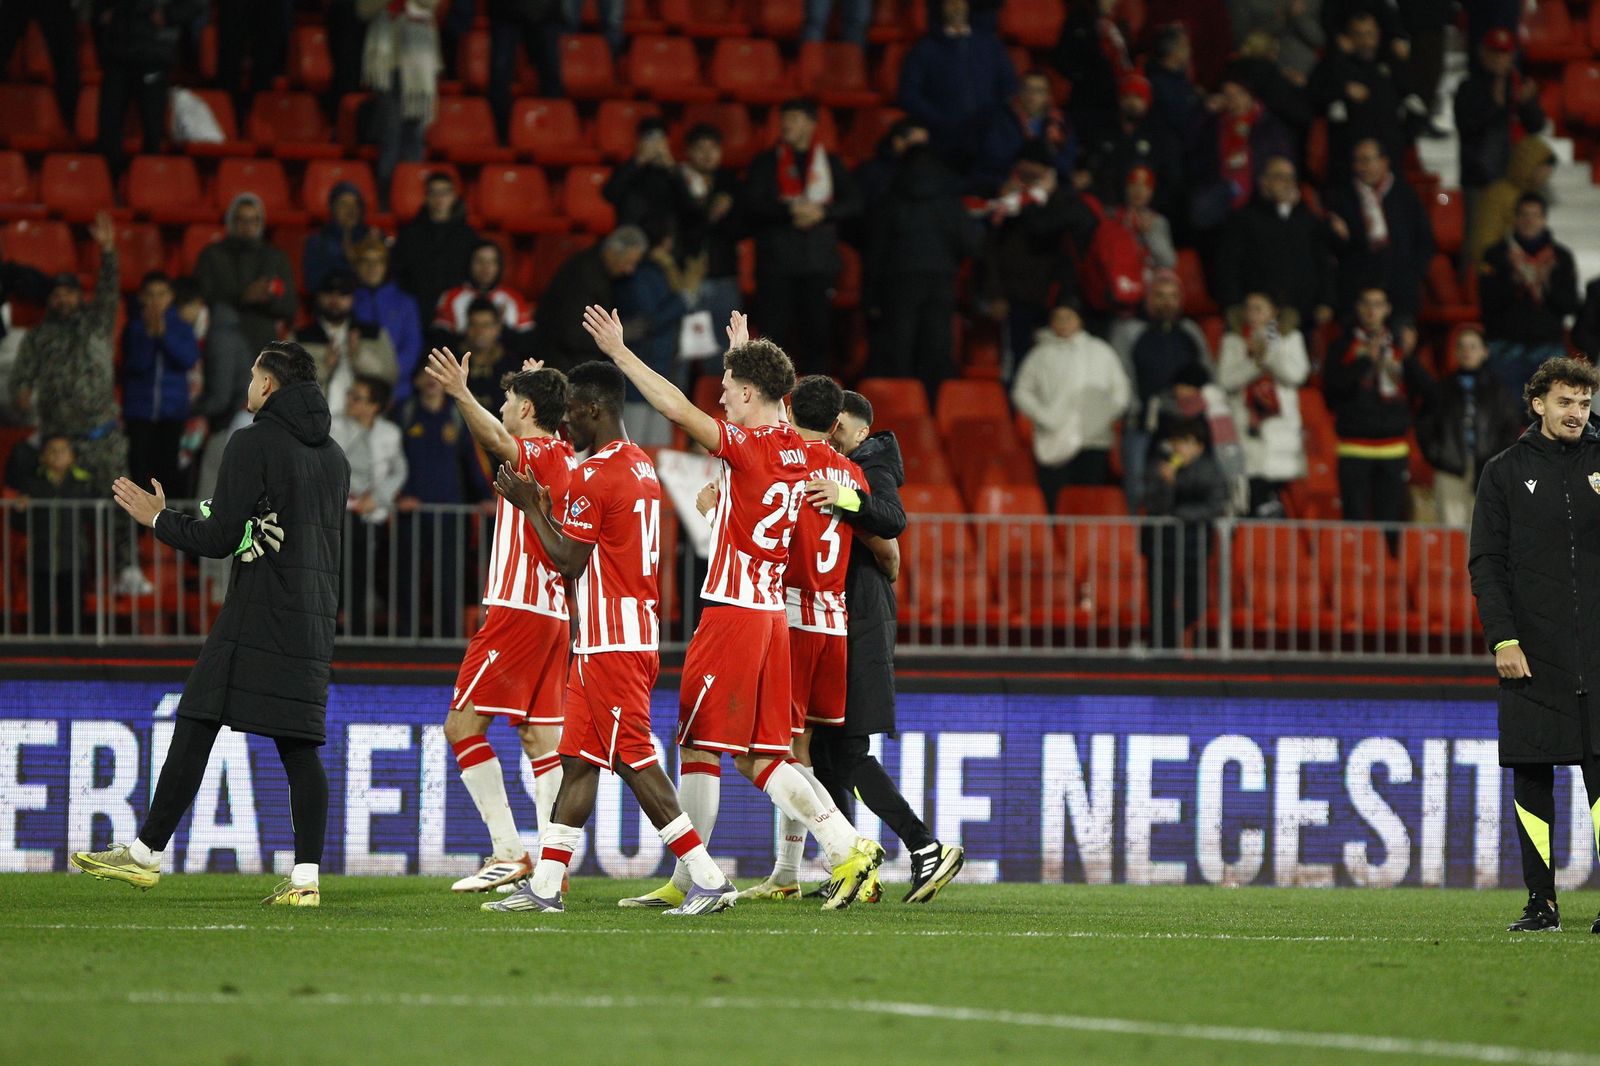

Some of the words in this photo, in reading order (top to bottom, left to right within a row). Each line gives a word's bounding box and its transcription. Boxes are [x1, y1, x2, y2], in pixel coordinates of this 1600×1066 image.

[632, 498, 660, 576] 14
[752, 480, 806, 550] 29
[816, 504, 841, 574] 3
[345, 724, 482, 877] EL
[785, 834, 803, 843] UDA
